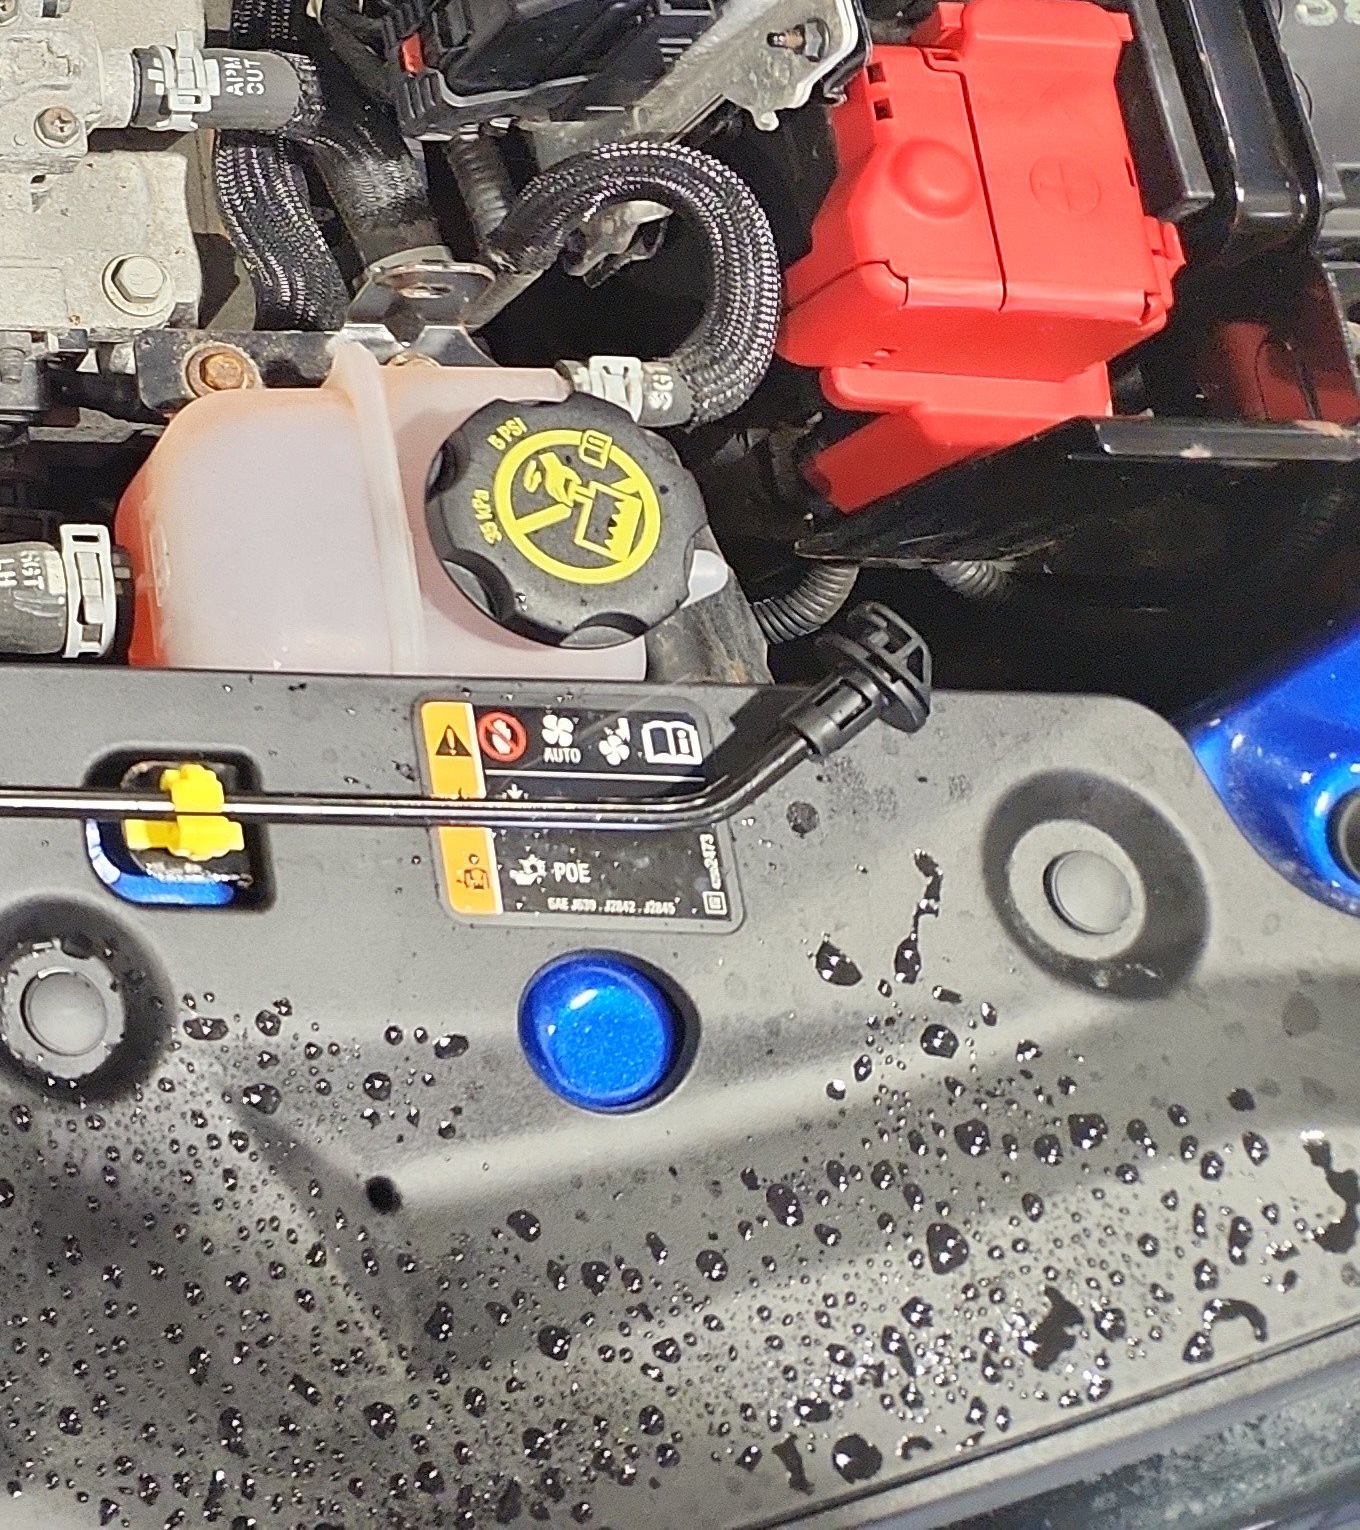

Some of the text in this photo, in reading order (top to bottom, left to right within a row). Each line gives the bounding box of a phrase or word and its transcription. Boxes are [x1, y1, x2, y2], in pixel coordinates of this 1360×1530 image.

[242, 58, 266, 95] OUT
[495, 416, 528, 443] PSI
[471, 489, 503, 545] 35 kPa
[543, 746, 582, 764] AUTO
[552, 861, 592, 884] POE
